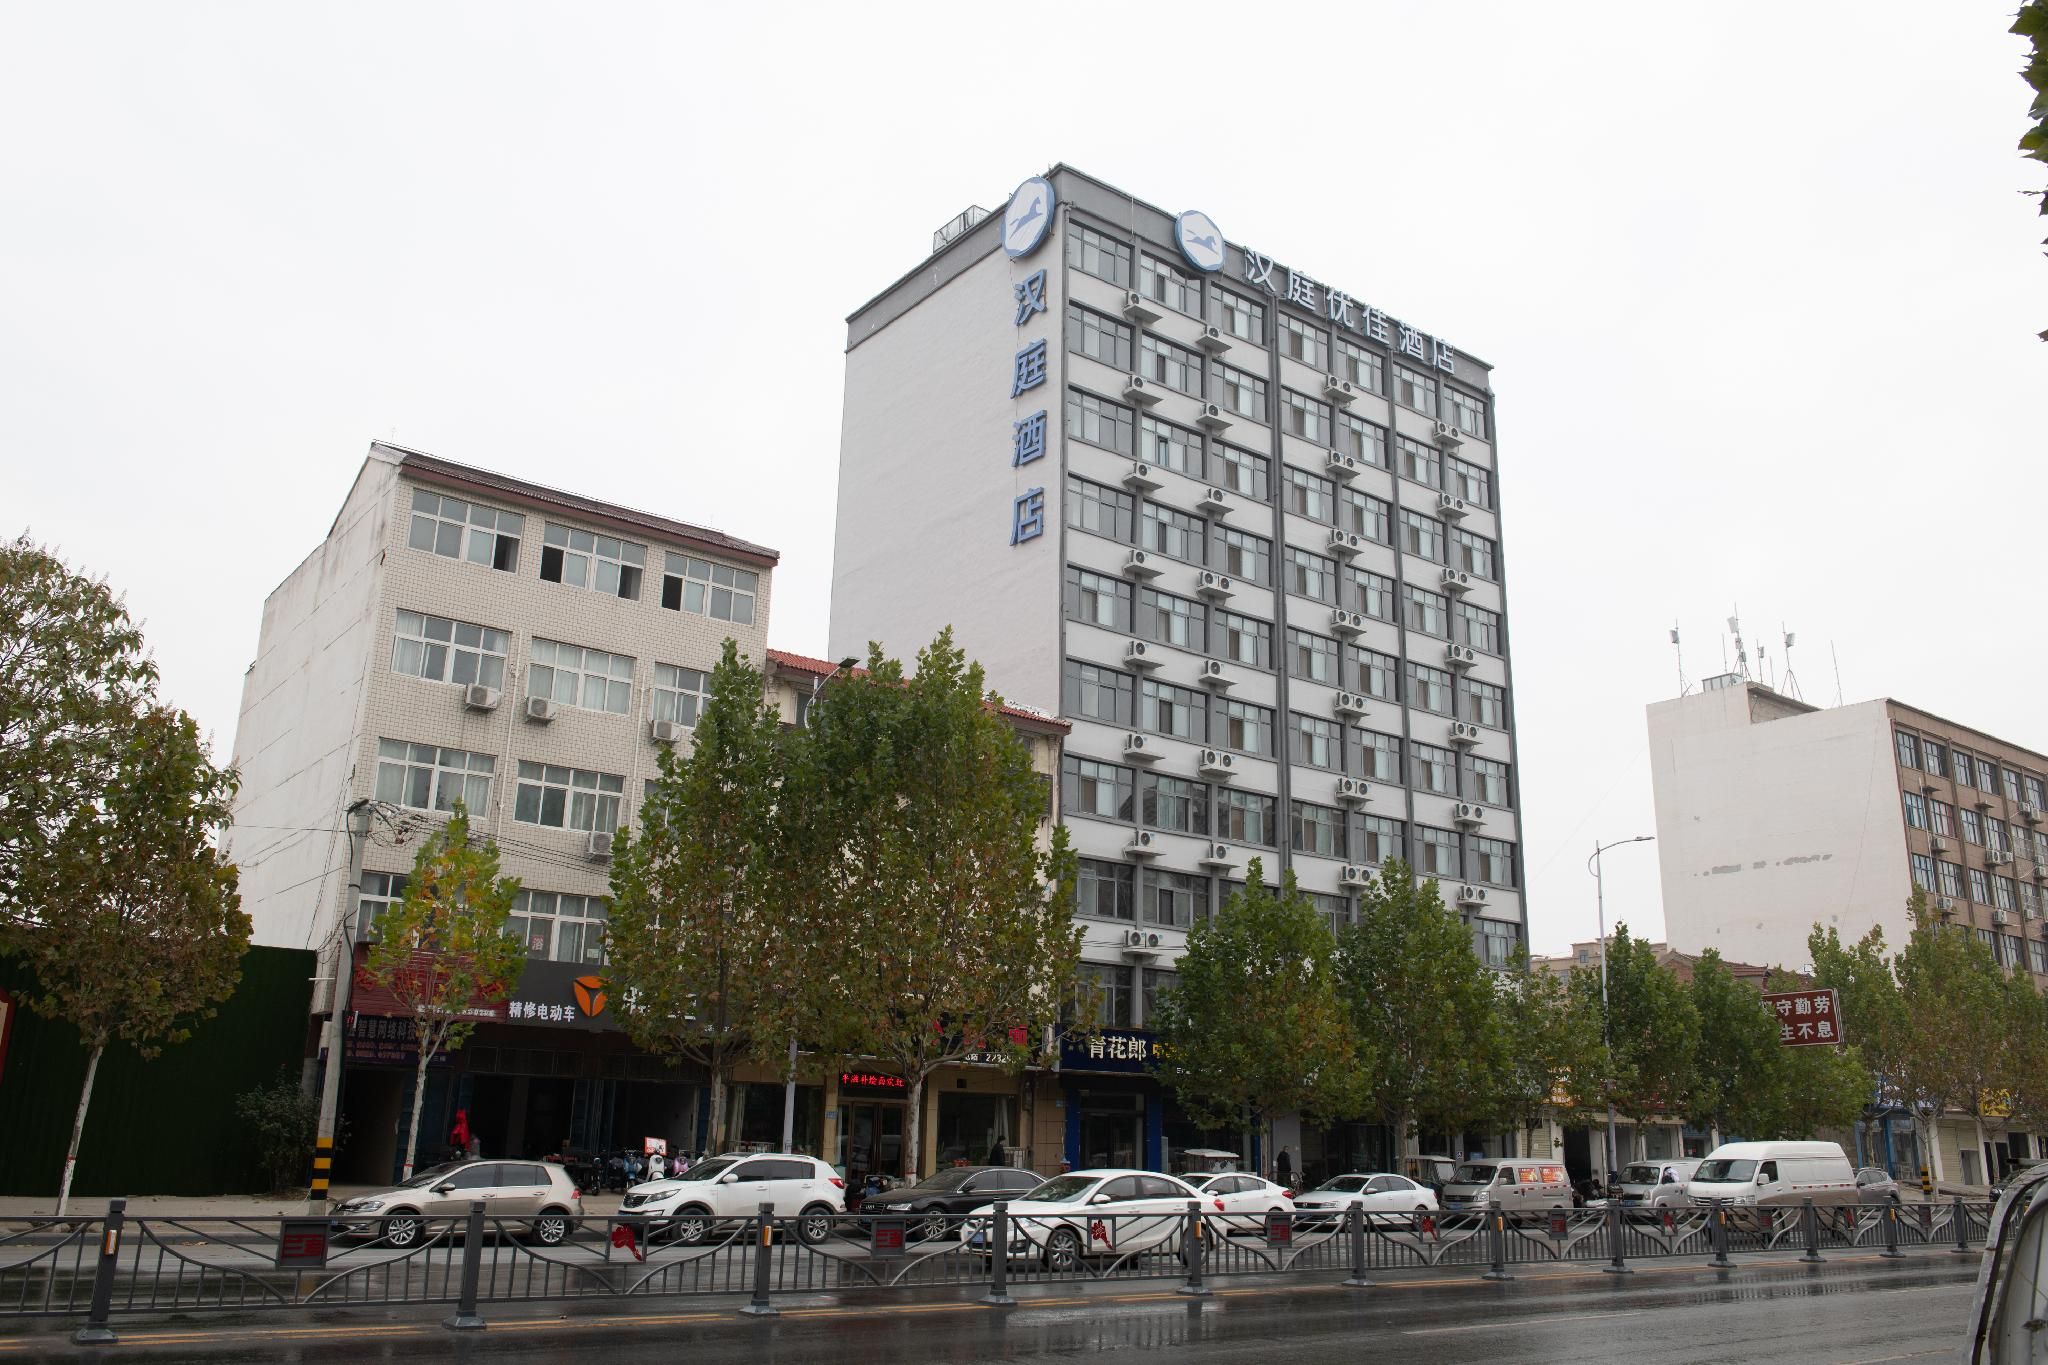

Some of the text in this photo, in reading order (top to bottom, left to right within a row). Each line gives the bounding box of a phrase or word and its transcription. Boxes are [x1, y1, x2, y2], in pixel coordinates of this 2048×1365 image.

[1243, 245, 1456, 376] 汉庭优佳酒店
[1009, 268, 1048, 547] 汉庭酒店
[508, 1000, 576, 1023] 精修电动车
[1780, 1020, 1834, 1041] 生不息
[1089, 1035, 1148, 1062] 青花郎
